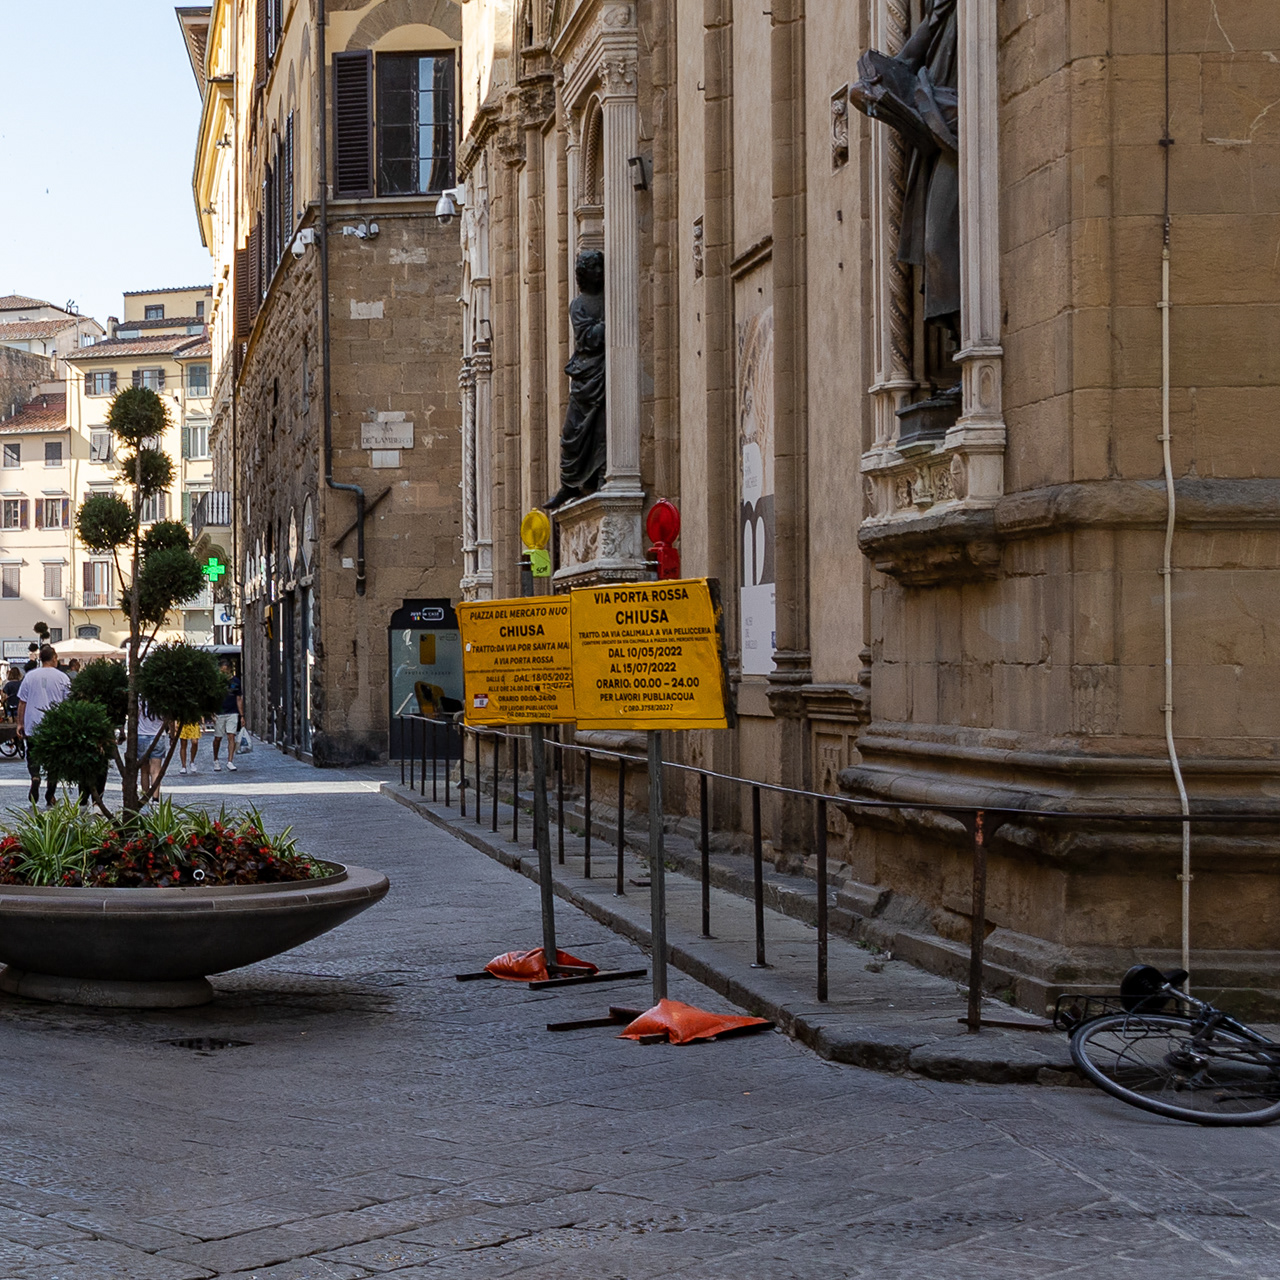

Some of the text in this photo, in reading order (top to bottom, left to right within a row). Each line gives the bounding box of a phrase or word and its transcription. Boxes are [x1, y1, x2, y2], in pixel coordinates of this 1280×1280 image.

[594, 588, 689, 604] VIA PORTA ROSSA
[470, 610, 494, 620] PIAZZA
[494, 610, 508, 619] DEL
[509, 608, 547, 618] MERCATO
[615, 609, 669, 625] CHIUSA
[499, 624, 545, 637] CHIUSA
[621, 628, 654, 638] CALIMALA
[674, 627, 711, 635] PELLICCERIA
[505, 643, 516, 651] VIA
[517, 643, 531, 651] POR
[532, 642, 556, 650] SANTA
[608, 646, 682, 659] DAL 10/05/2022
[493, 655, 554, 665] A VIA PORTA ROSSA
[610, 662, 677, 675] AL 15/07/2022
[513, 674, 530, 683] DAL
[633, 678, 662, 688] 00.00
[671, 677, 700, 688] 24.00
[600, 692, 695, 701] PER LAVORI PUBLIACQUA
